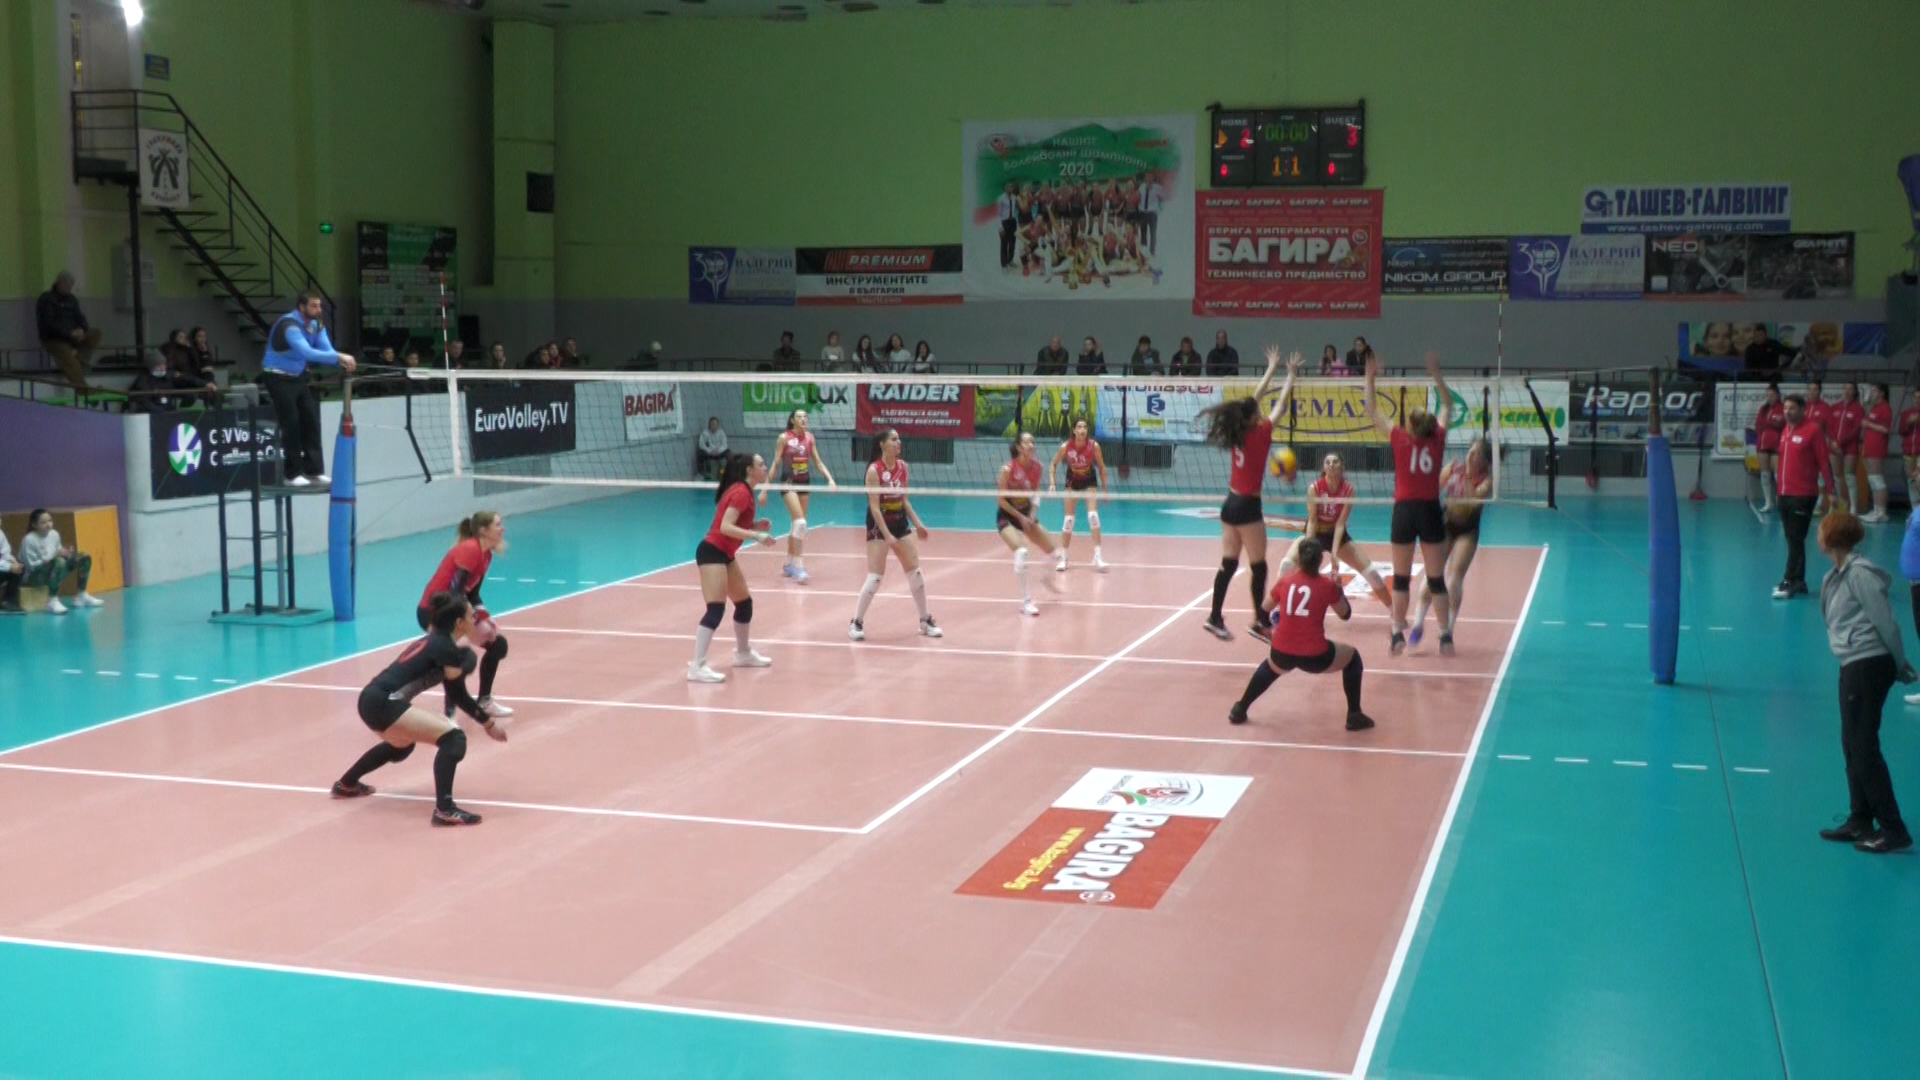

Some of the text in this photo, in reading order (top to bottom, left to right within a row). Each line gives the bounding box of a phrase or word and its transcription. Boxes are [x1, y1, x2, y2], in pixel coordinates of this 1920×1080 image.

[1221, 118, 1248, 126] HOME
[1346, 125, 1359, 148] 3
[1058, 161, 1094, 177] 2020
[1208, 227, 1349, 235] ВЕРИГА ХИПЕРМАРКЕТИ
[1607, 222, 1764, 233] www.tashev-galving.com
[1208, 236, 1355, 264] БАГИРА
[1652, 241, 1698, 252] NEO
[849, 254, 926, 266] PREMIUM
[826, 275, 928, 286] ИНСТРУМЕНТИТЕ
[1207, 270, 1366, 280] ТЕХНИЧЕСКО ПРЕДИМСТВО
[868, 384, 960, 402] RAIDER
[624, 392, 675, 416] BAGIRA
[474, 401, 569, 433] EuroVolley.TV
[1409, 446, 1433, 473] 16
[1286, 583, 1312, 616] 12
[1042, 811, 1170, 892] BAGIRA
